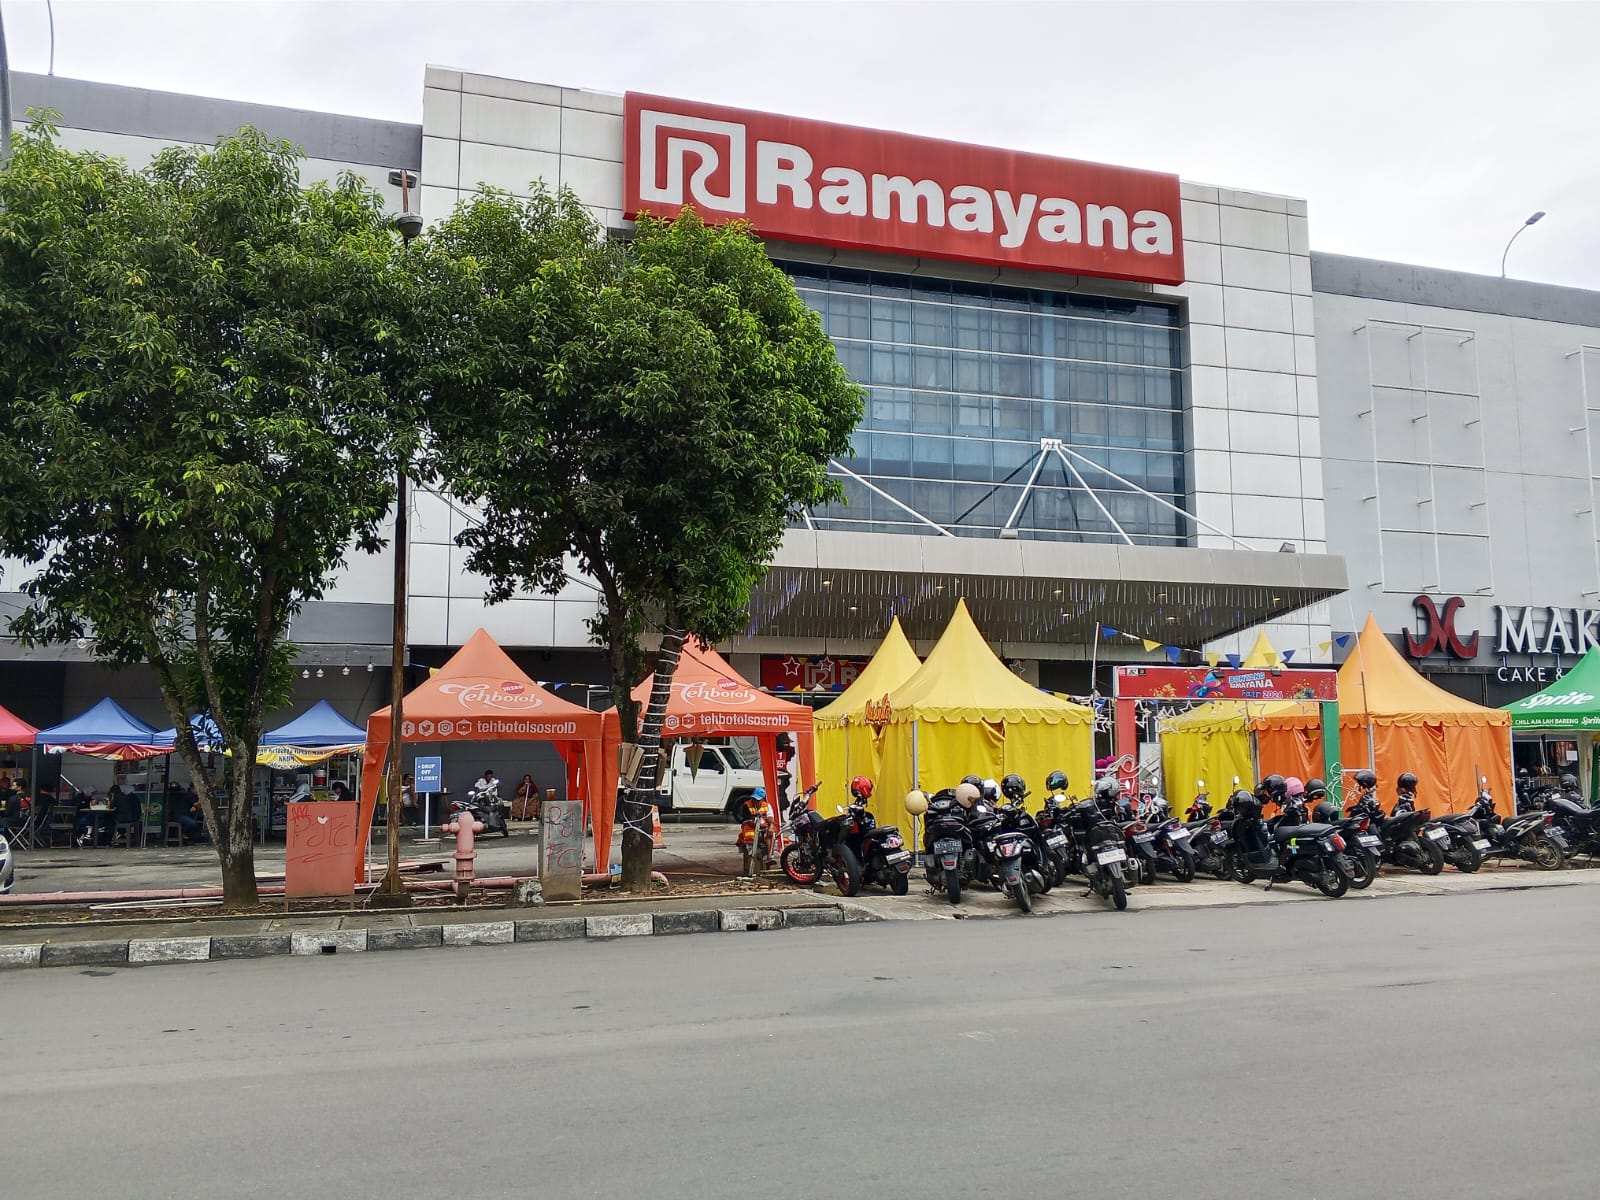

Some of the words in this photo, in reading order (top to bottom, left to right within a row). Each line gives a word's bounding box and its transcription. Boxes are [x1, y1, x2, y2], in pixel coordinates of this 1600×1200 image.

[756, 139, 1174, 255] Ramayana
[1497, 666, 1547, 682] CAKE
[1520, 691, 1595, 709] Sprite
